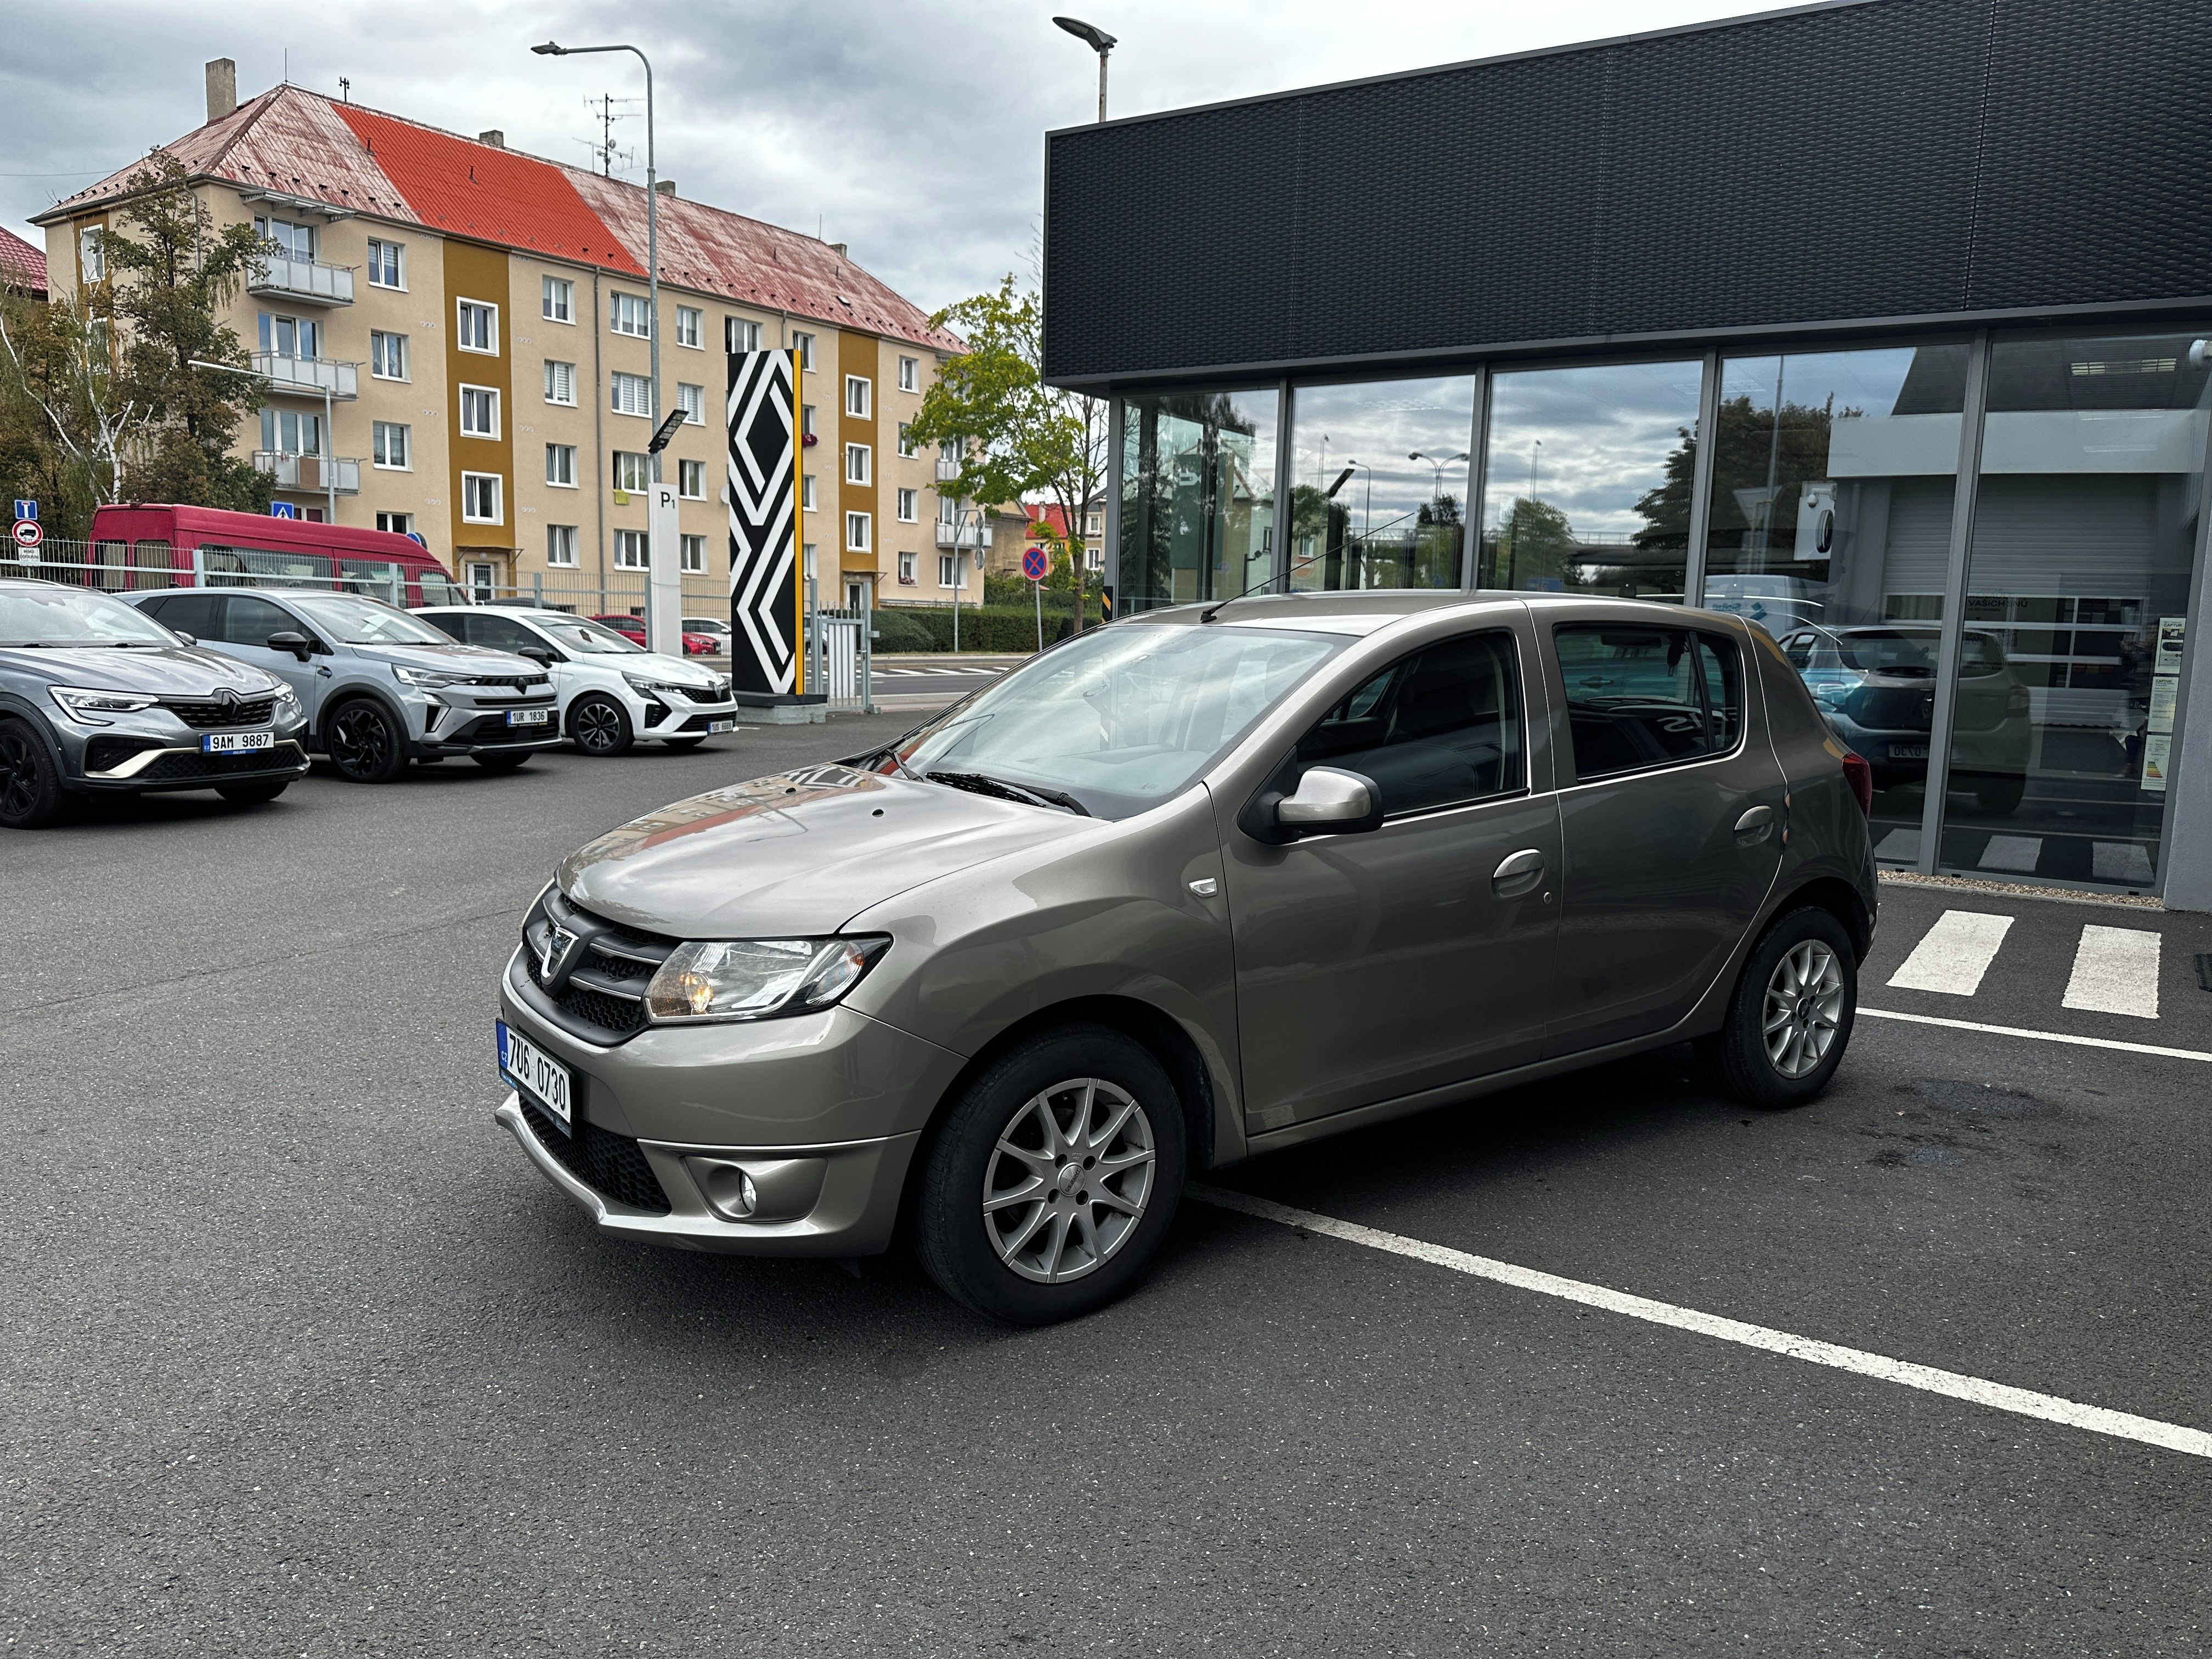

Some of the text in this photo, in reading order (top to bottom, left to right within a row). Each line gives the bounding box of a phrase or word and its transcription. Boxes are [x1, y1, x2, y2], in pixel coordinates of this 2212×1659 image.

[1968, 599, 2005, 607] VAŠICH
[513, 711, 545, 722] 1UR 1836
[213, 734, 269, 749] 9AM 9887
[501, 1051, 507, 1063] CZ
[509, 1032, 529, 1080] 7U6
[538, 1056, 566, 1111] 0730
